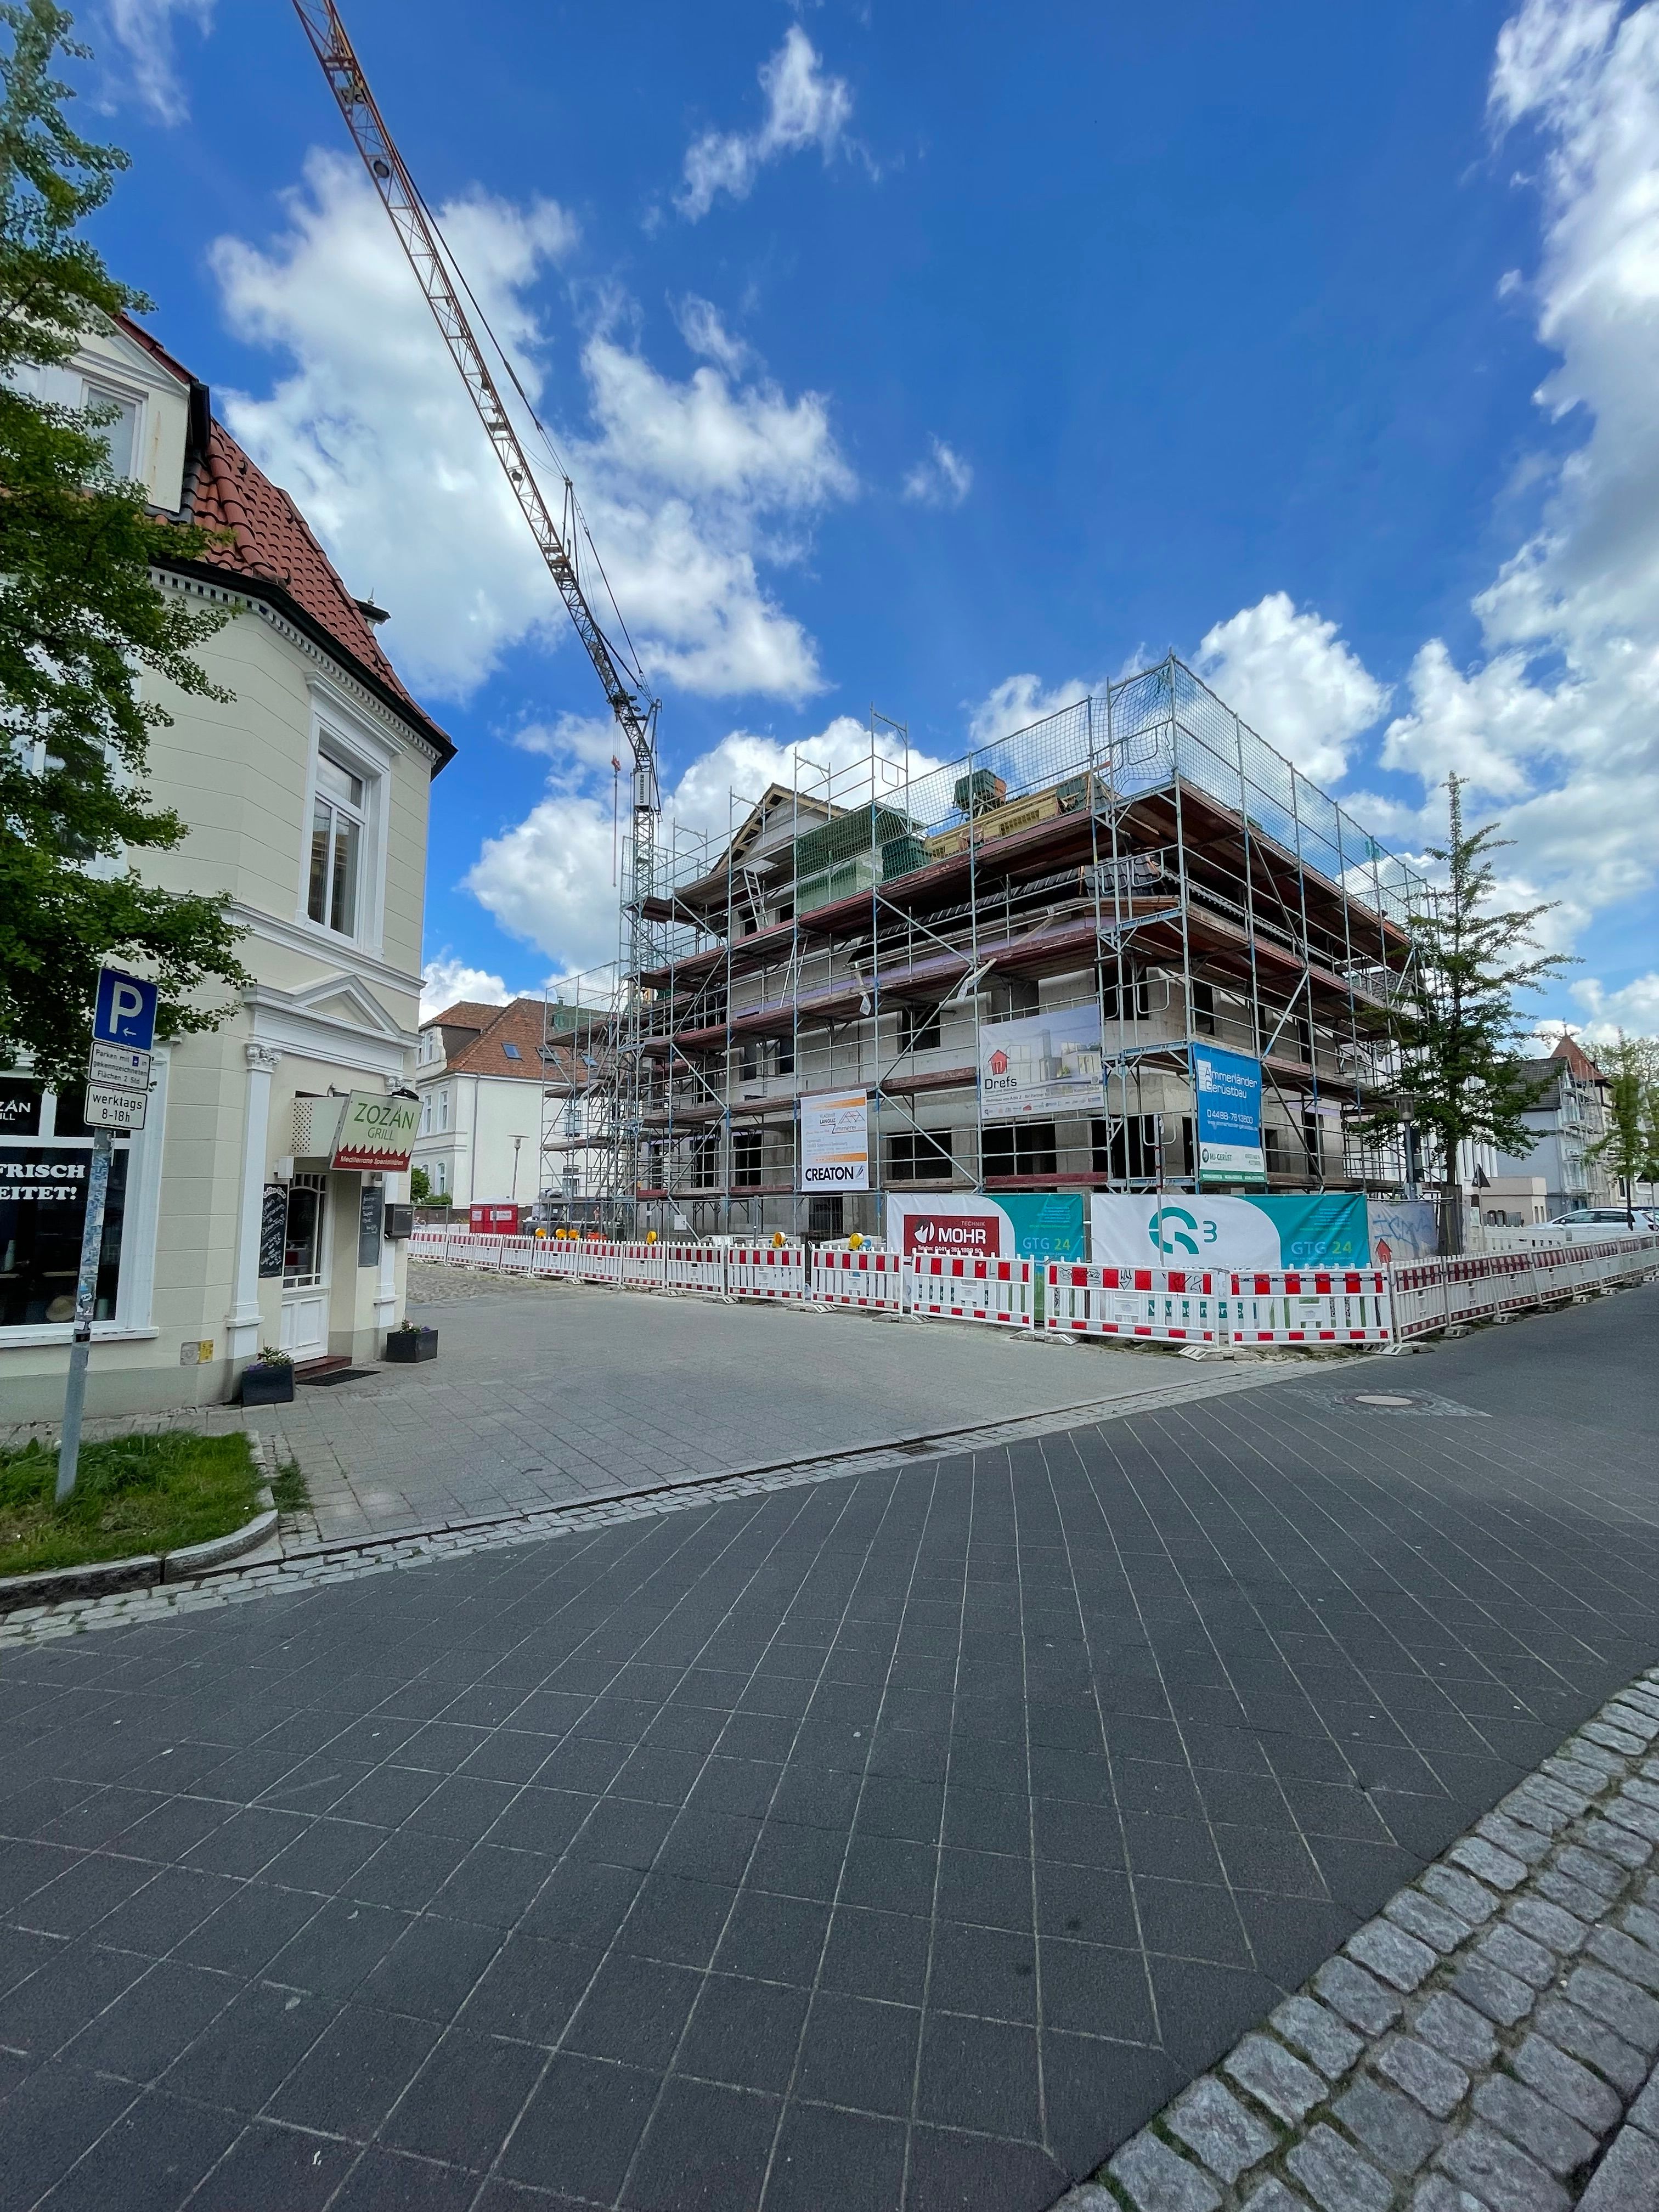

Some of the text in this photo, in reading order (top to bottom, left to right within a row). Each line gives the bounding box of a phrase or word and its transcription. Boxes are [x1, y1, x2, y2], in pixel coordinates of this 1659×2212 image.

[109, 981, 143, 1034] P
[95, 1048, 117, 1059] Parken
[984, 1076, 1017, 1090] Drefs
[1205, 1067, 1257, 1088] Ammerländer
[1205, 1080, 1247, 1098] Gerüstbau
[92, 1093, 143, 1111] werktags
[101, 1108, 130, 1122] 8-18h
[368, 1127, 394, 1141] GRILL
[805, 1166, 854, 1181] CREATON
[0, 1186, 77, 1200] EITET!
[938, 1227, 986, 1244] MOHR
[1023, 1237, 1071, 1250] GTG 24
[1291, 1241, 1352, 1255] GTG 24
